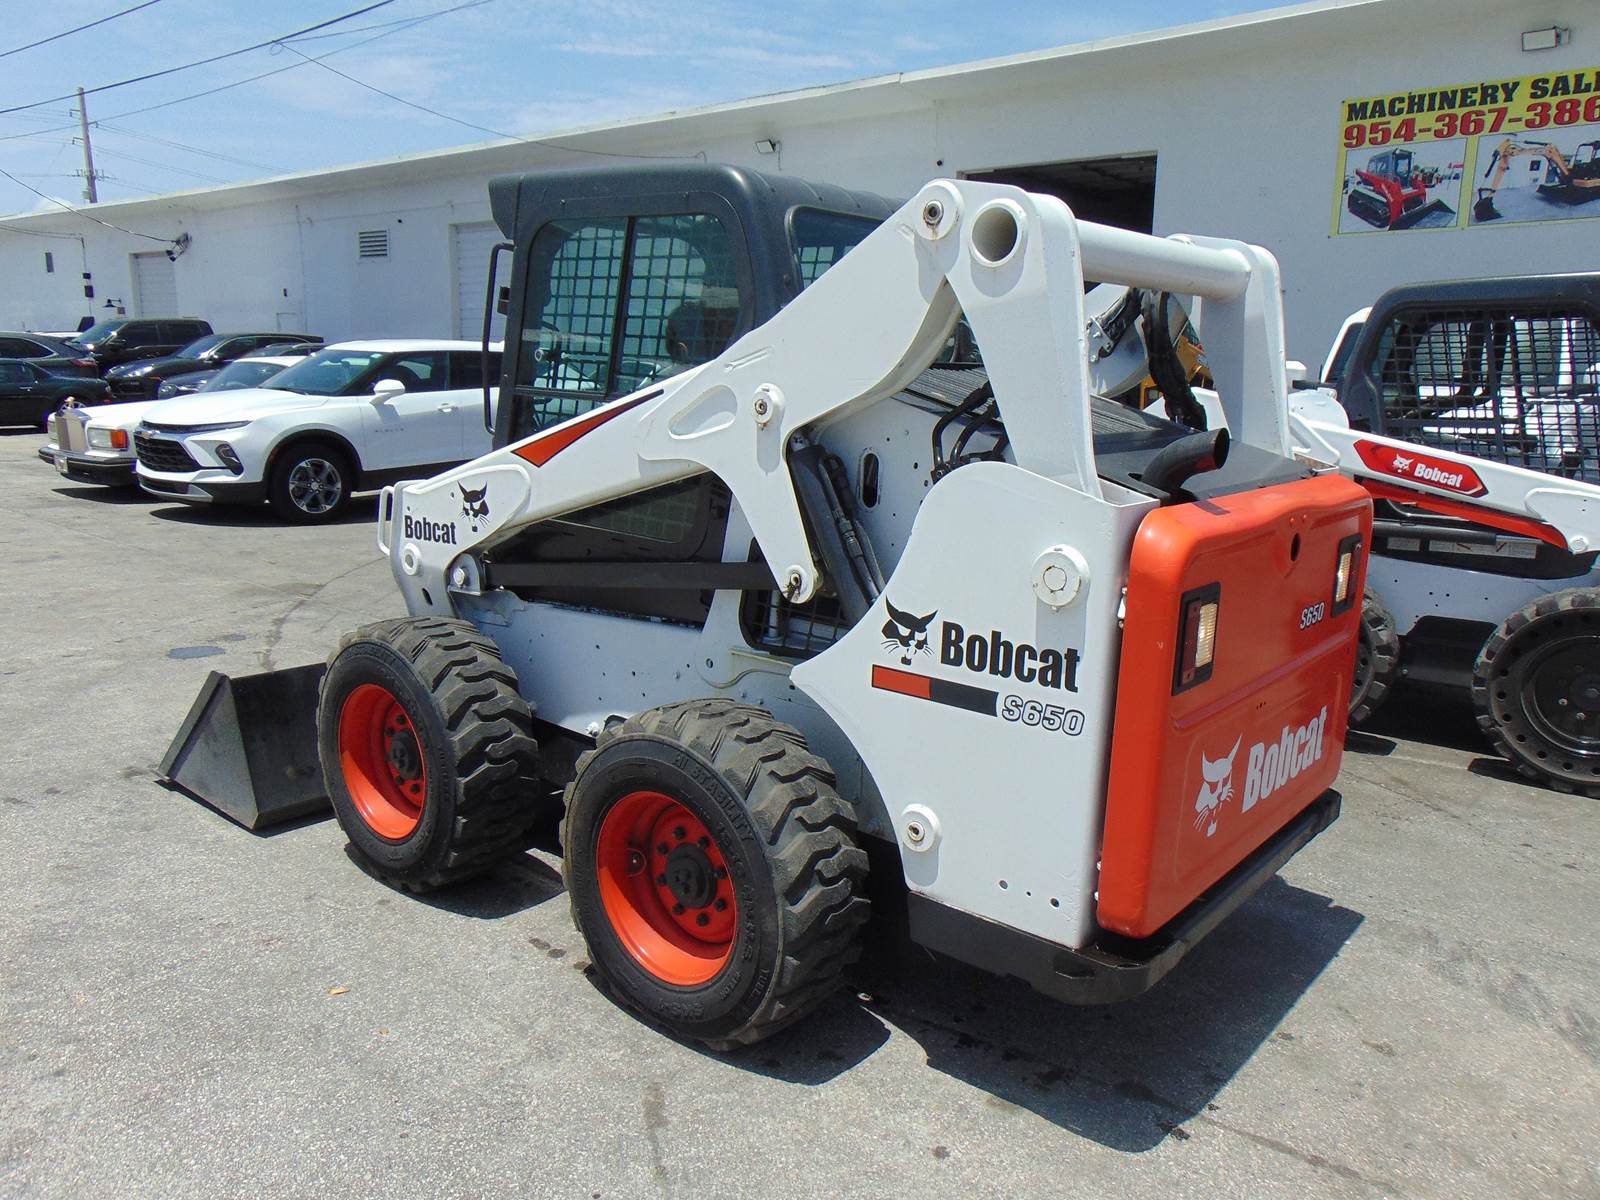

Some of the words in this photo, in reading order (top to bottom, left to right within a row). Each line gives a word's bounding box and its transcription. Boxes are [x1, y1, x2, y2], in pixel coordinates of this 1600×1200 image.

[1346, 81, 1520, 122] MACHINERY
[1413, 462, 1464, 488] Bobcat
[404, 515, 457, 545] Bobcat
[1299, 602, 1326, 631] S650
[940, 620, 1081, 693] Bobcat
[1001, 694, 1086, 737] S650
[1241, 704, 1328, 814] Bobcat
